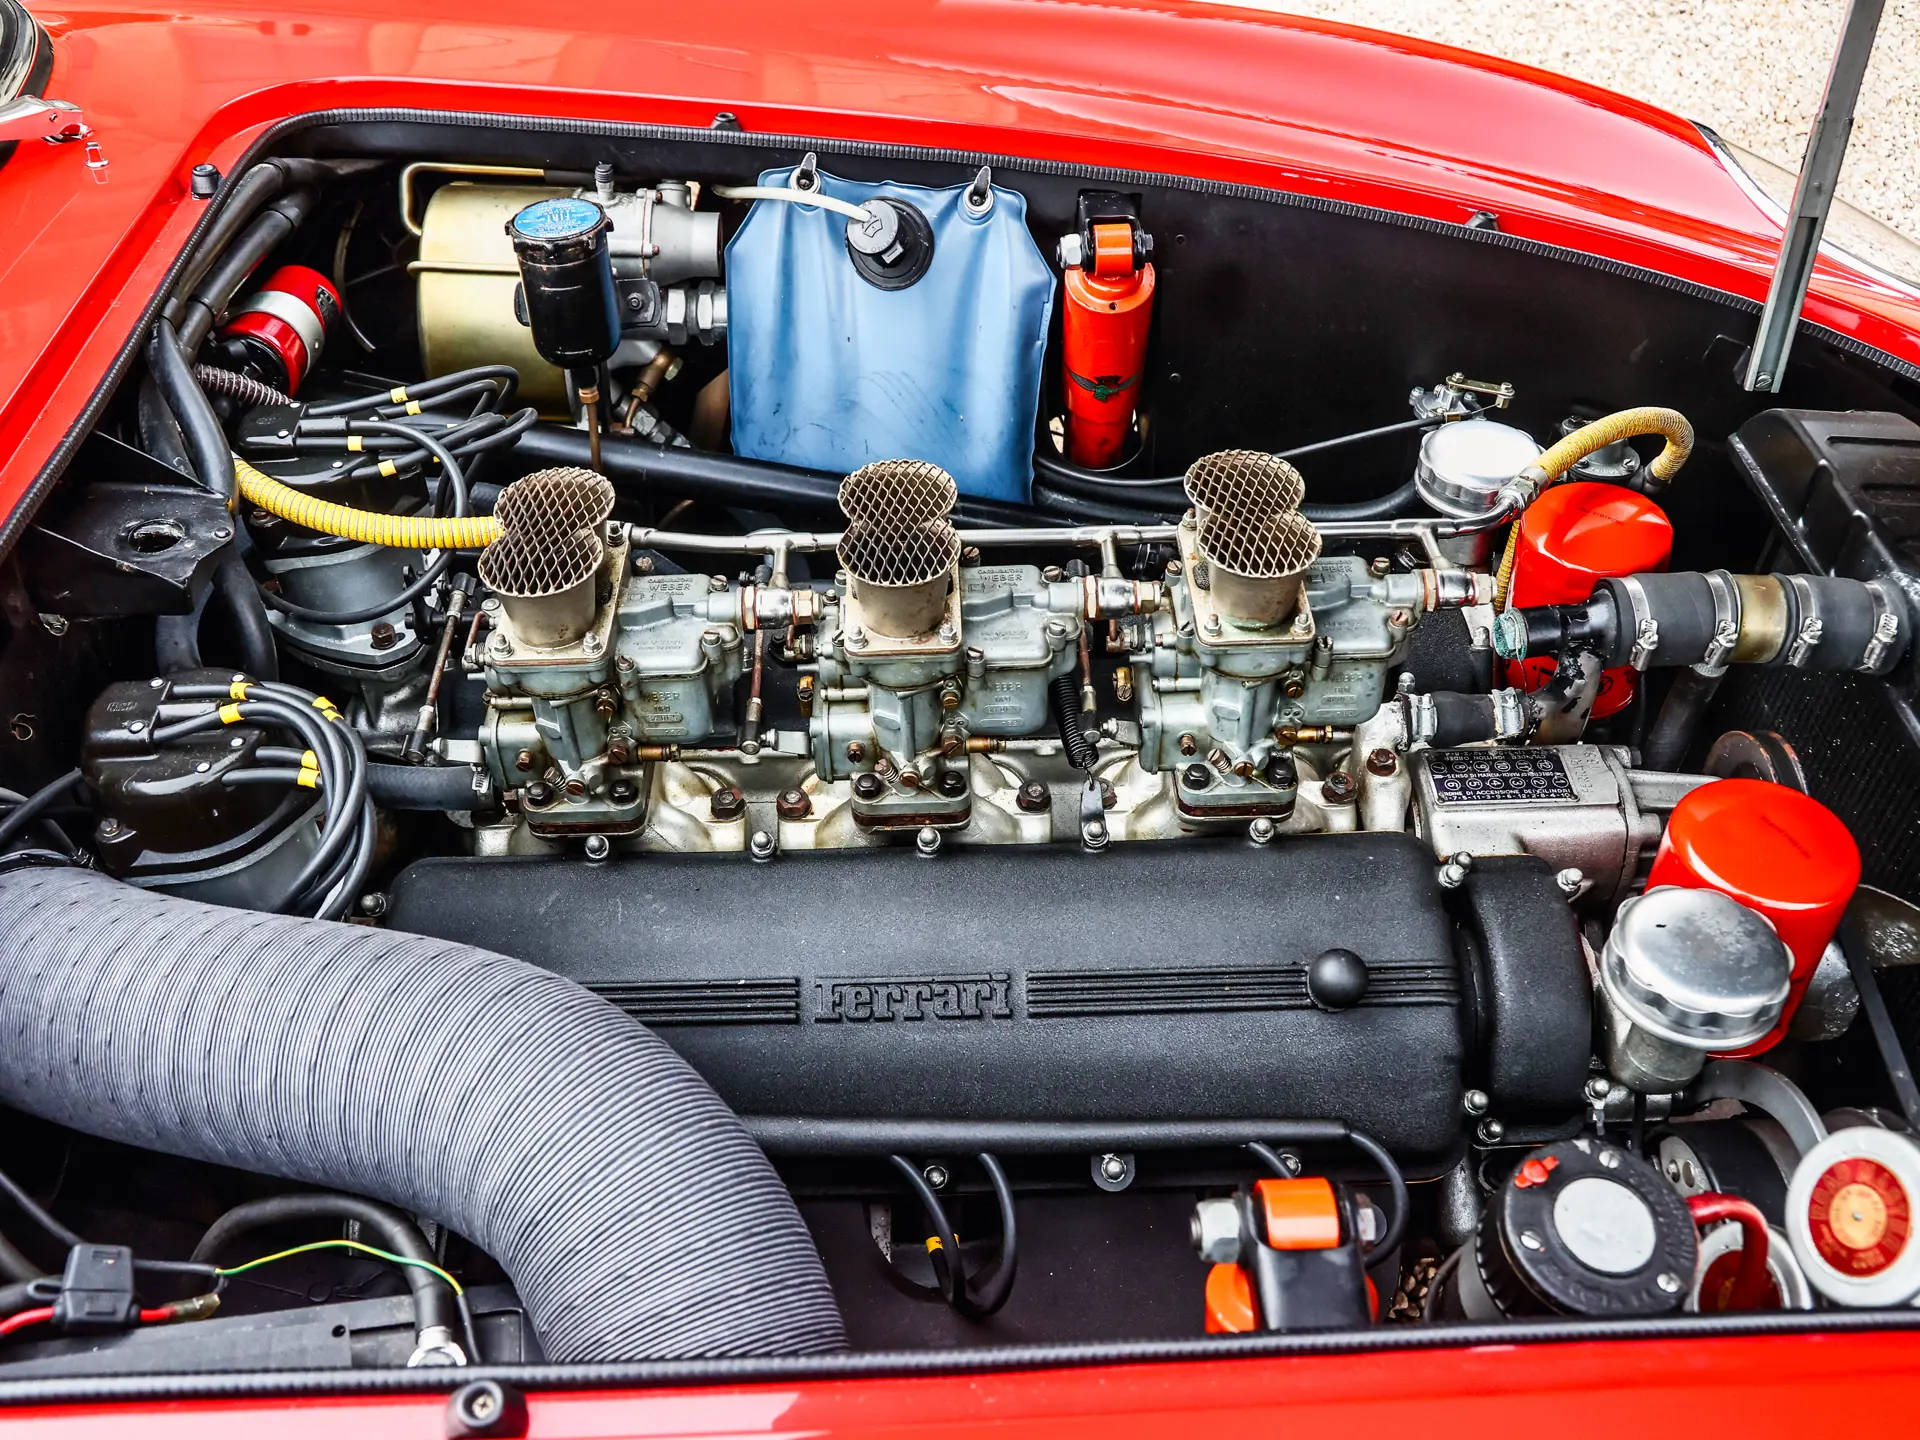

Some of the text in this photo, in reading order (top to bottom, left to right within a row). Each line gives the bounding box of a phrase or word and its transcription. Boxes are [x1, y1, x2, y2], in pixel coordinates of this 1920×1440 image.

[980, 574, 1023, 582] WEBER
[650, 583, 691, 591] WEBER
[814, 974, 1013, 1023] Ferrari
